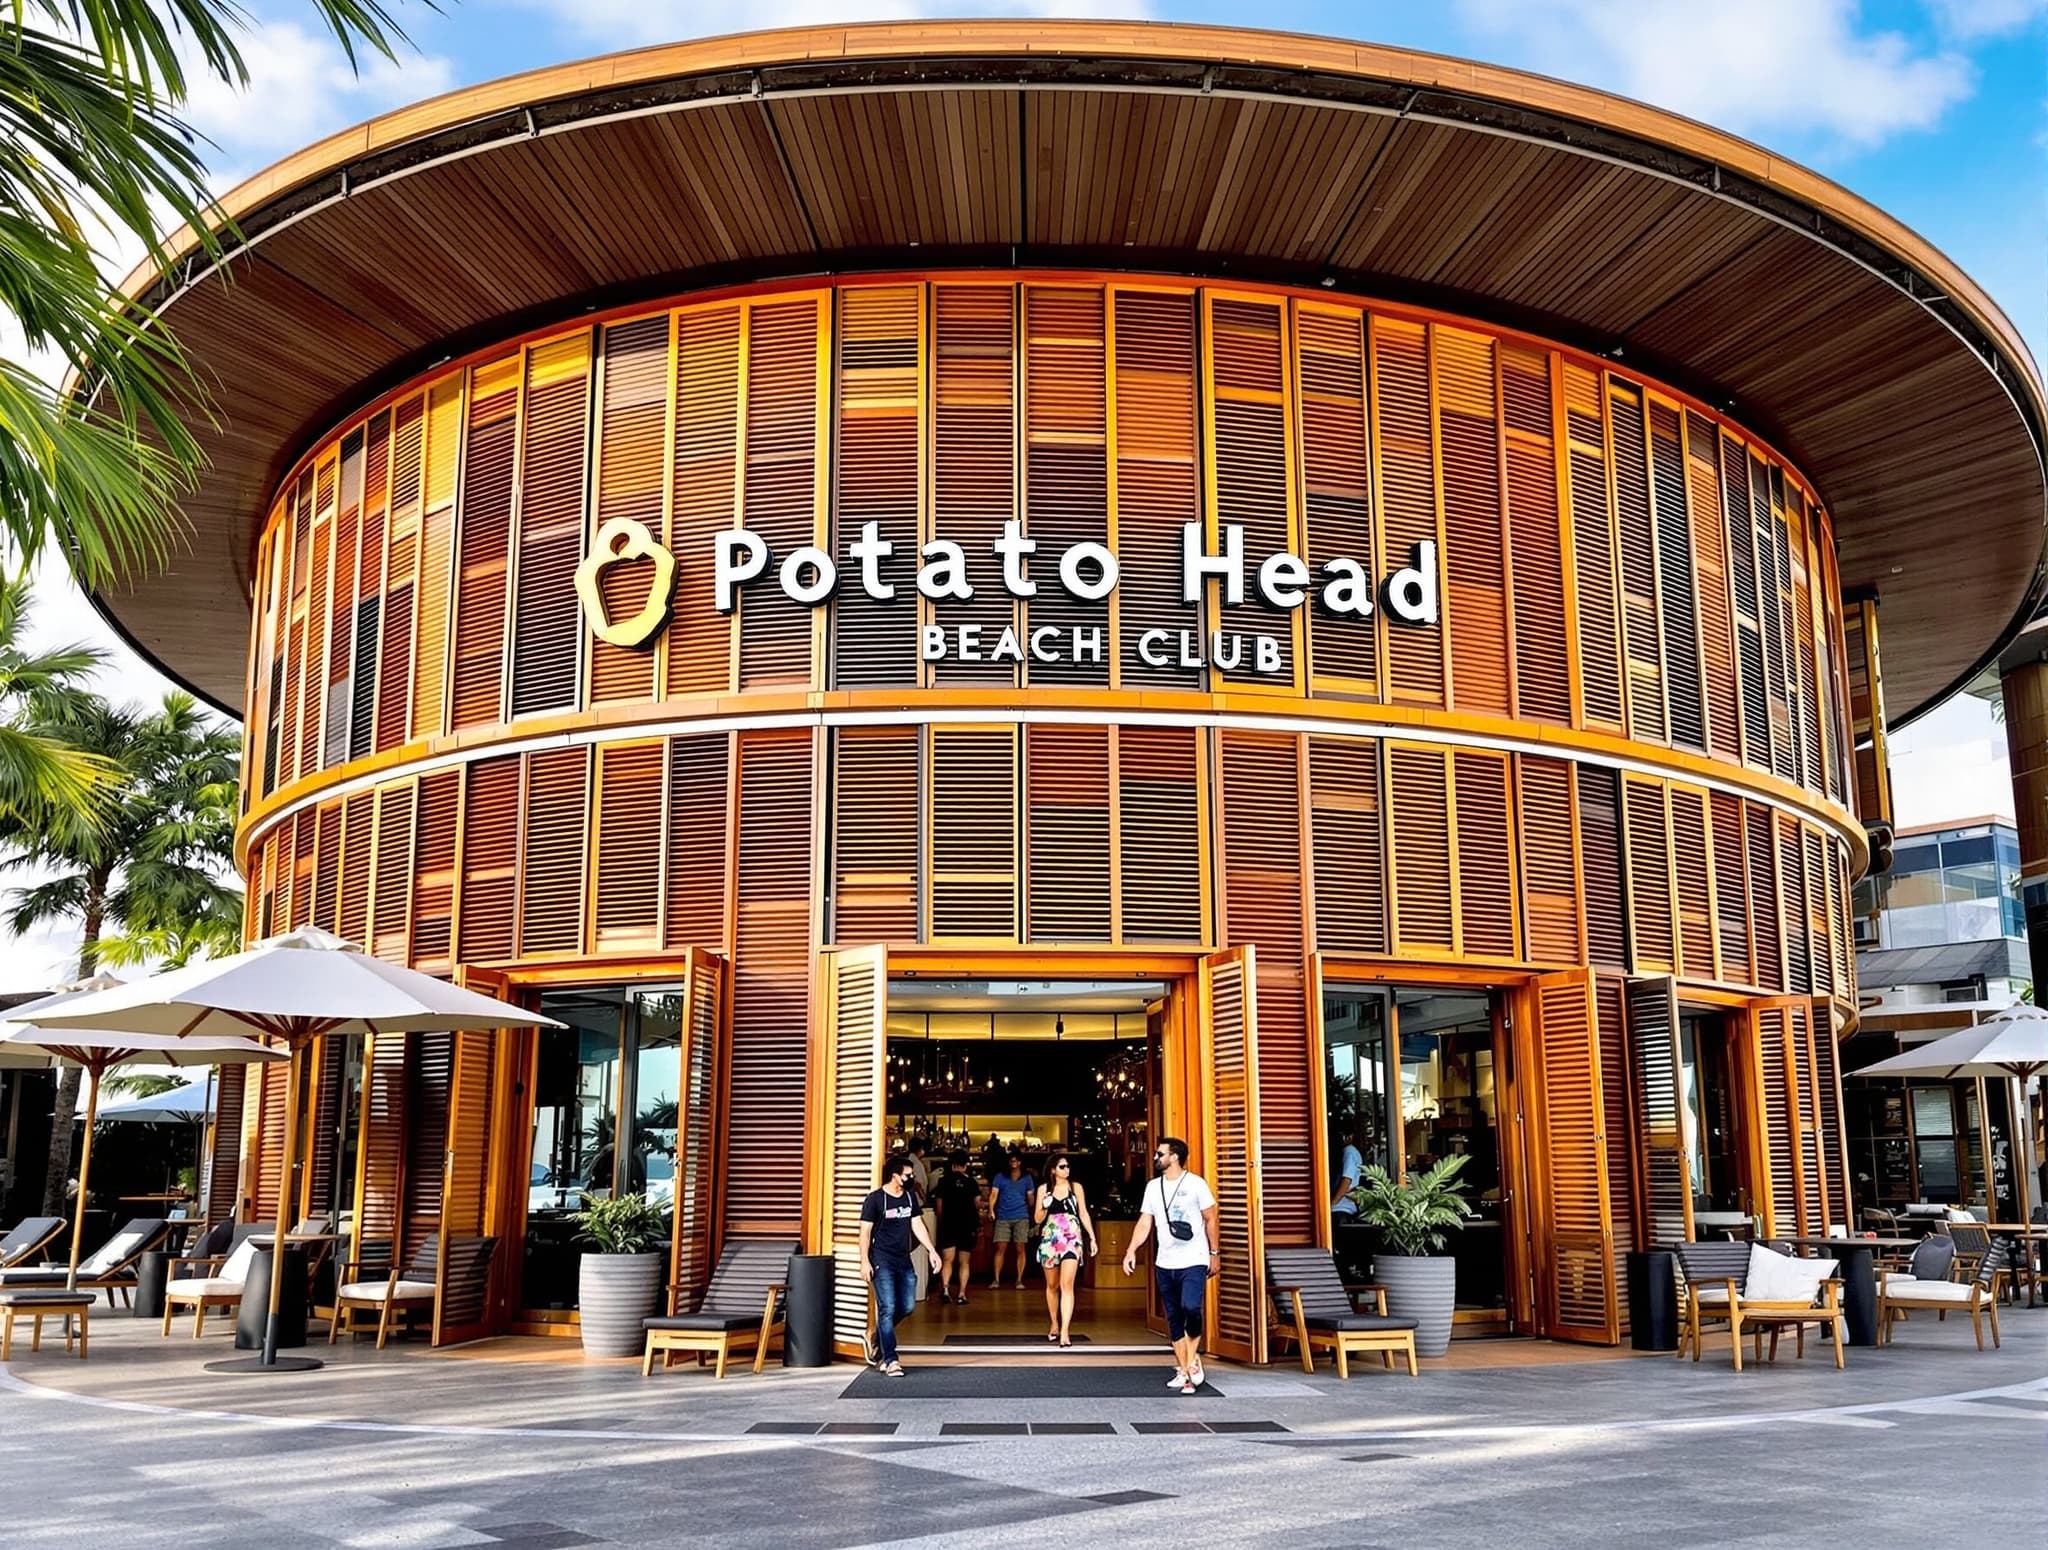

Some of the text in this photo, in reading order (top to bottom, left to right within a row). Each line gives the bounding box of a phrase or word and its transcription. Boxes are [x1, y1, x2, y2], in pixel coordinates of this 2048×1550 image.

[713, 519, 1438, 625] Potato Head
[922, 624, 1282, 673] BEACH CLUB
